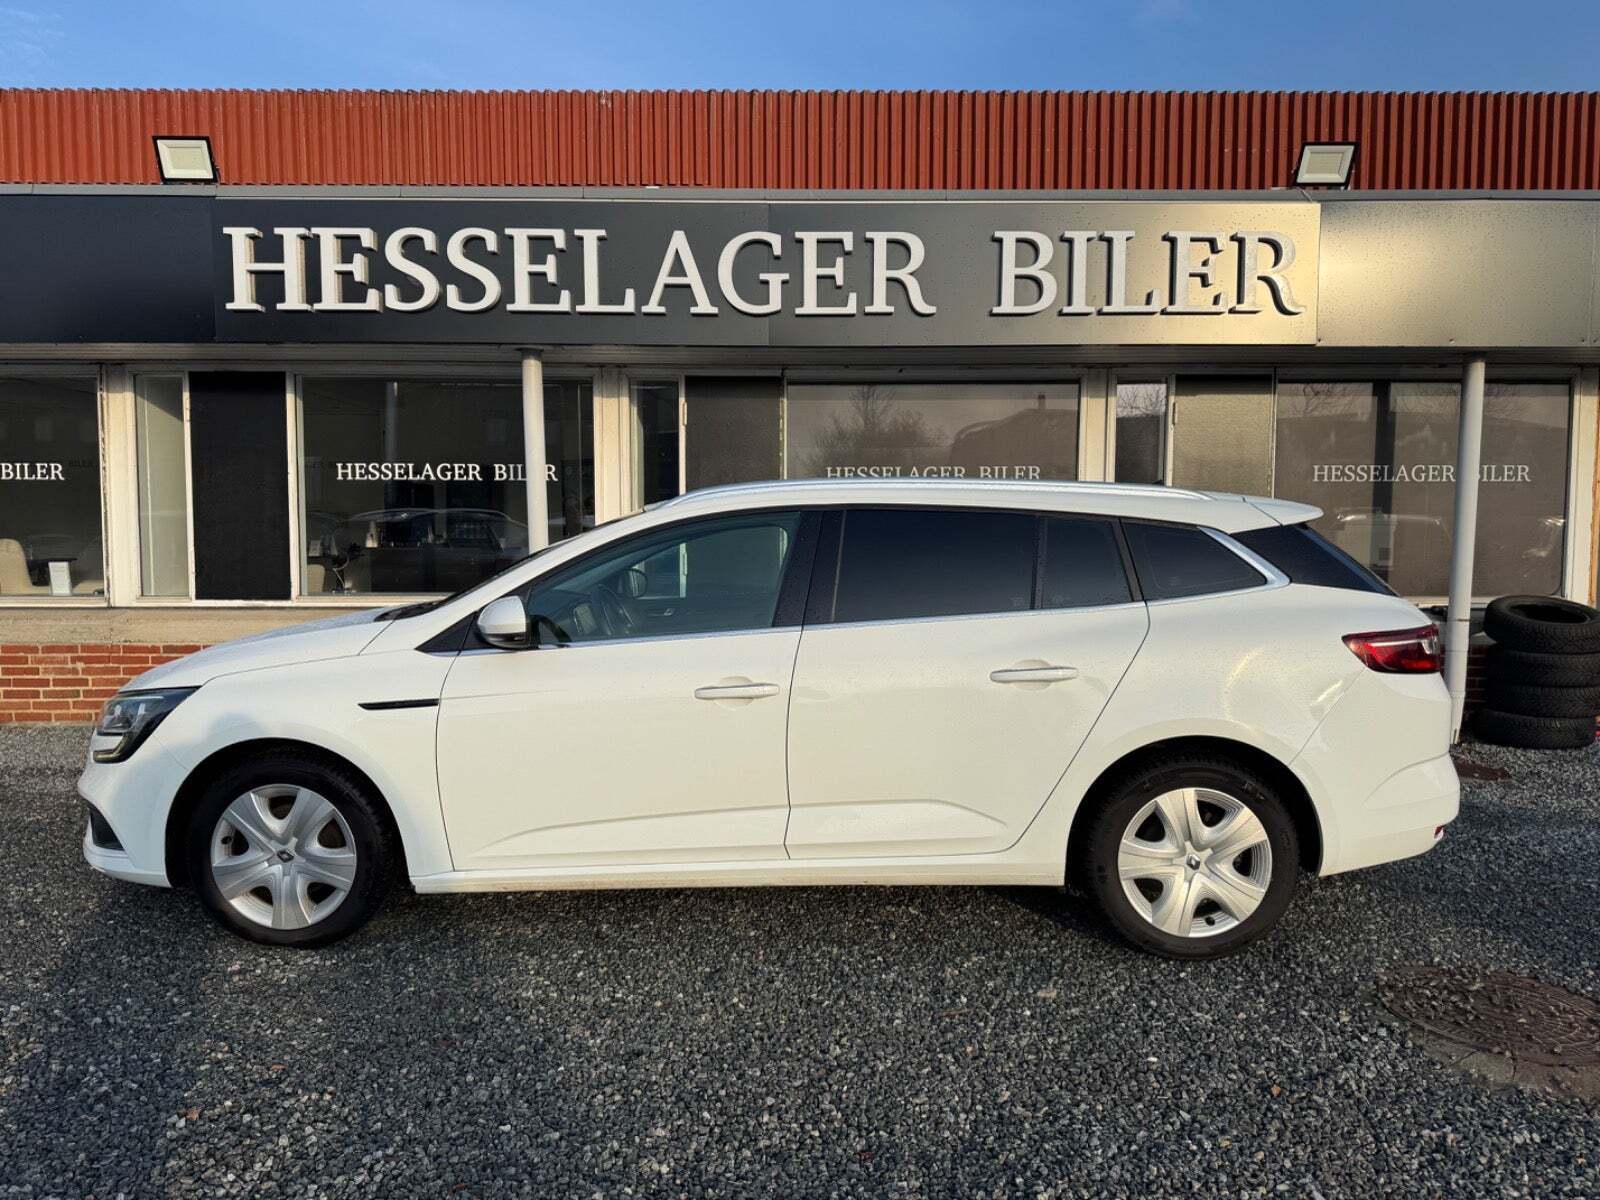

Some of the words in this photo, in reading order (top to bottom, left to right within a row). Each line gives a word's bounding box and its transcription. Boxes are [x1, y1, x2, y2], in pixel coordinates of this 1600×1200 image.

[223, 226, 937, 315] HESSELAGER
[991, 229, 1306, 315] BILER
[0, 462, 65, 481] BILER
[335, 462, 483, 481] HESSELAGER
[493, 463, 559, 482] BILR
[1312, 464, 1456, 482] HESSELAGER
[1476, 464, 1532, 482] ILER
